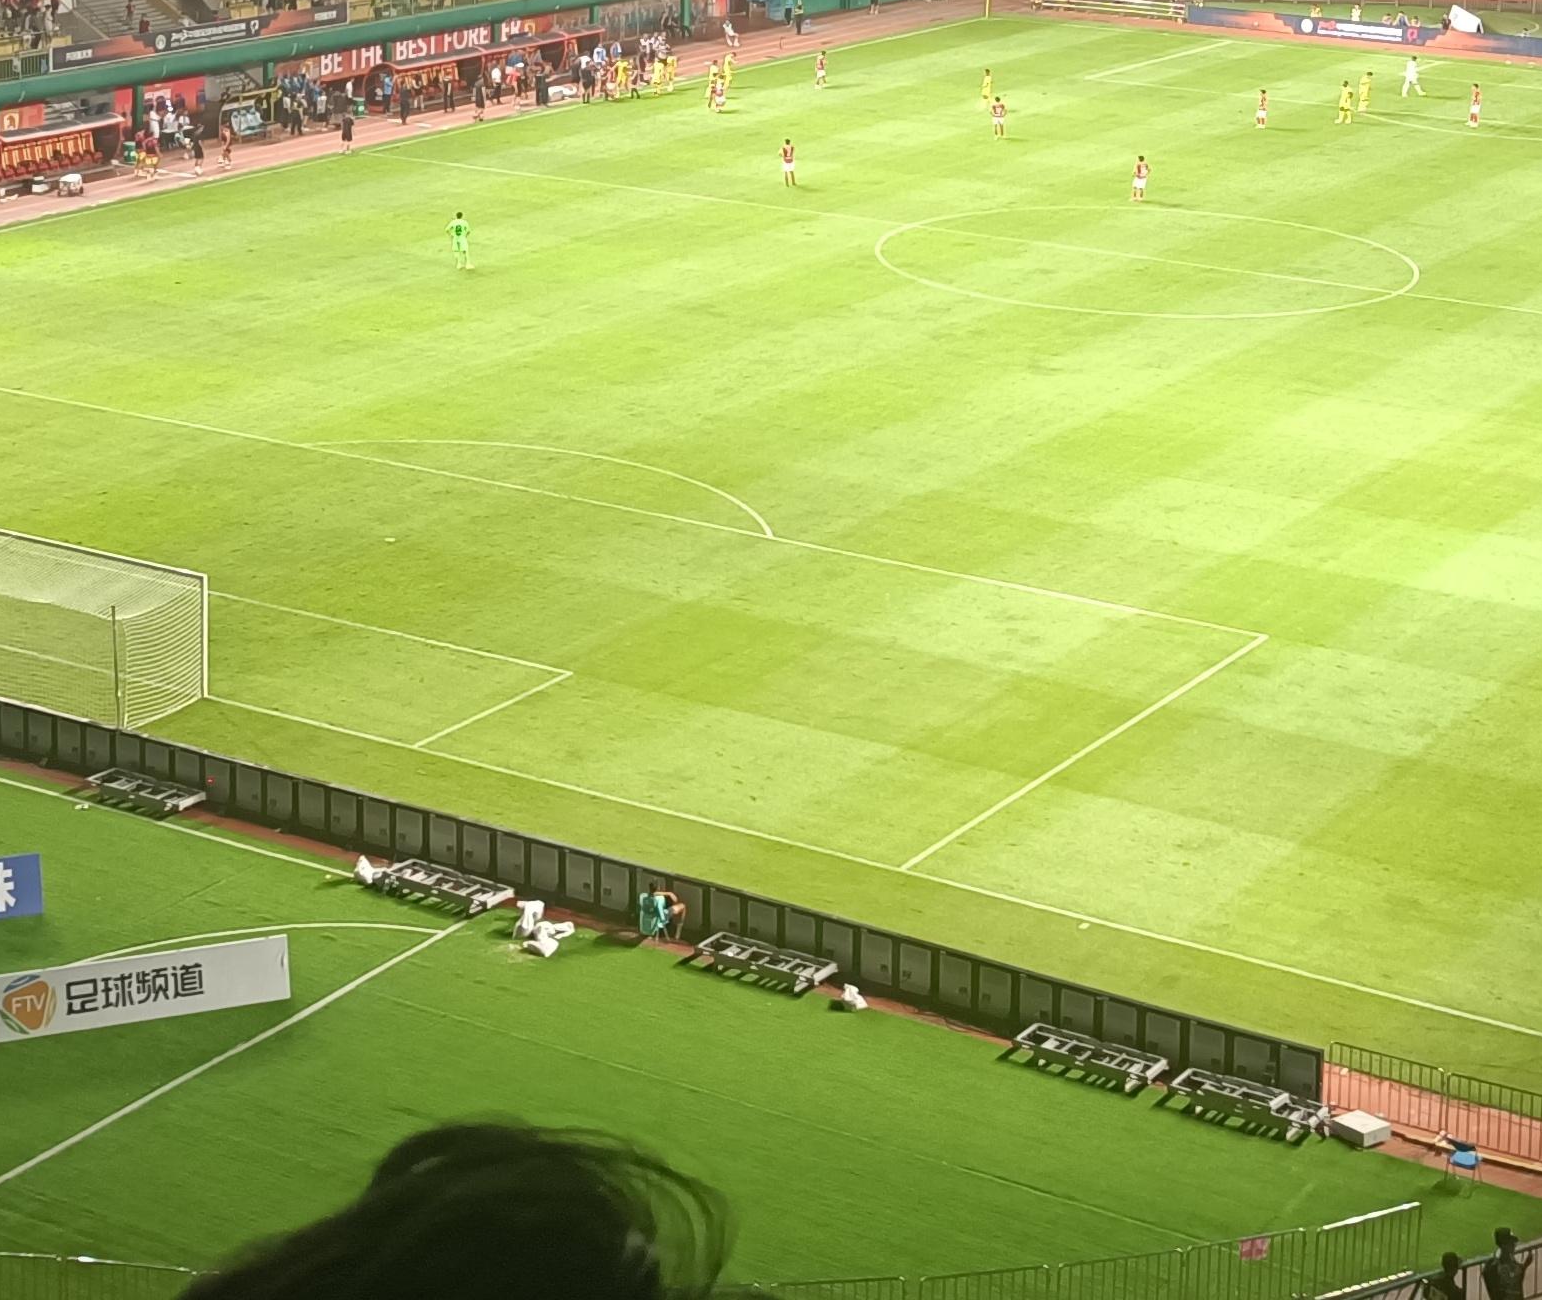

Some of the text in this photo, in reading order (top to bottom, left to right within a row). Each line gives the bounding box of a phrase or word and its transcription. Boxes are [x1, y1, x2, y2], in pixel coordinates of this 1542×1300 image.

[321, 52, 342, 75] BE
[444, 19, 522, 52] FOREER
[12, 992, 46, 1015] FTV
[65, 963, 204, 1015] 足球频道
